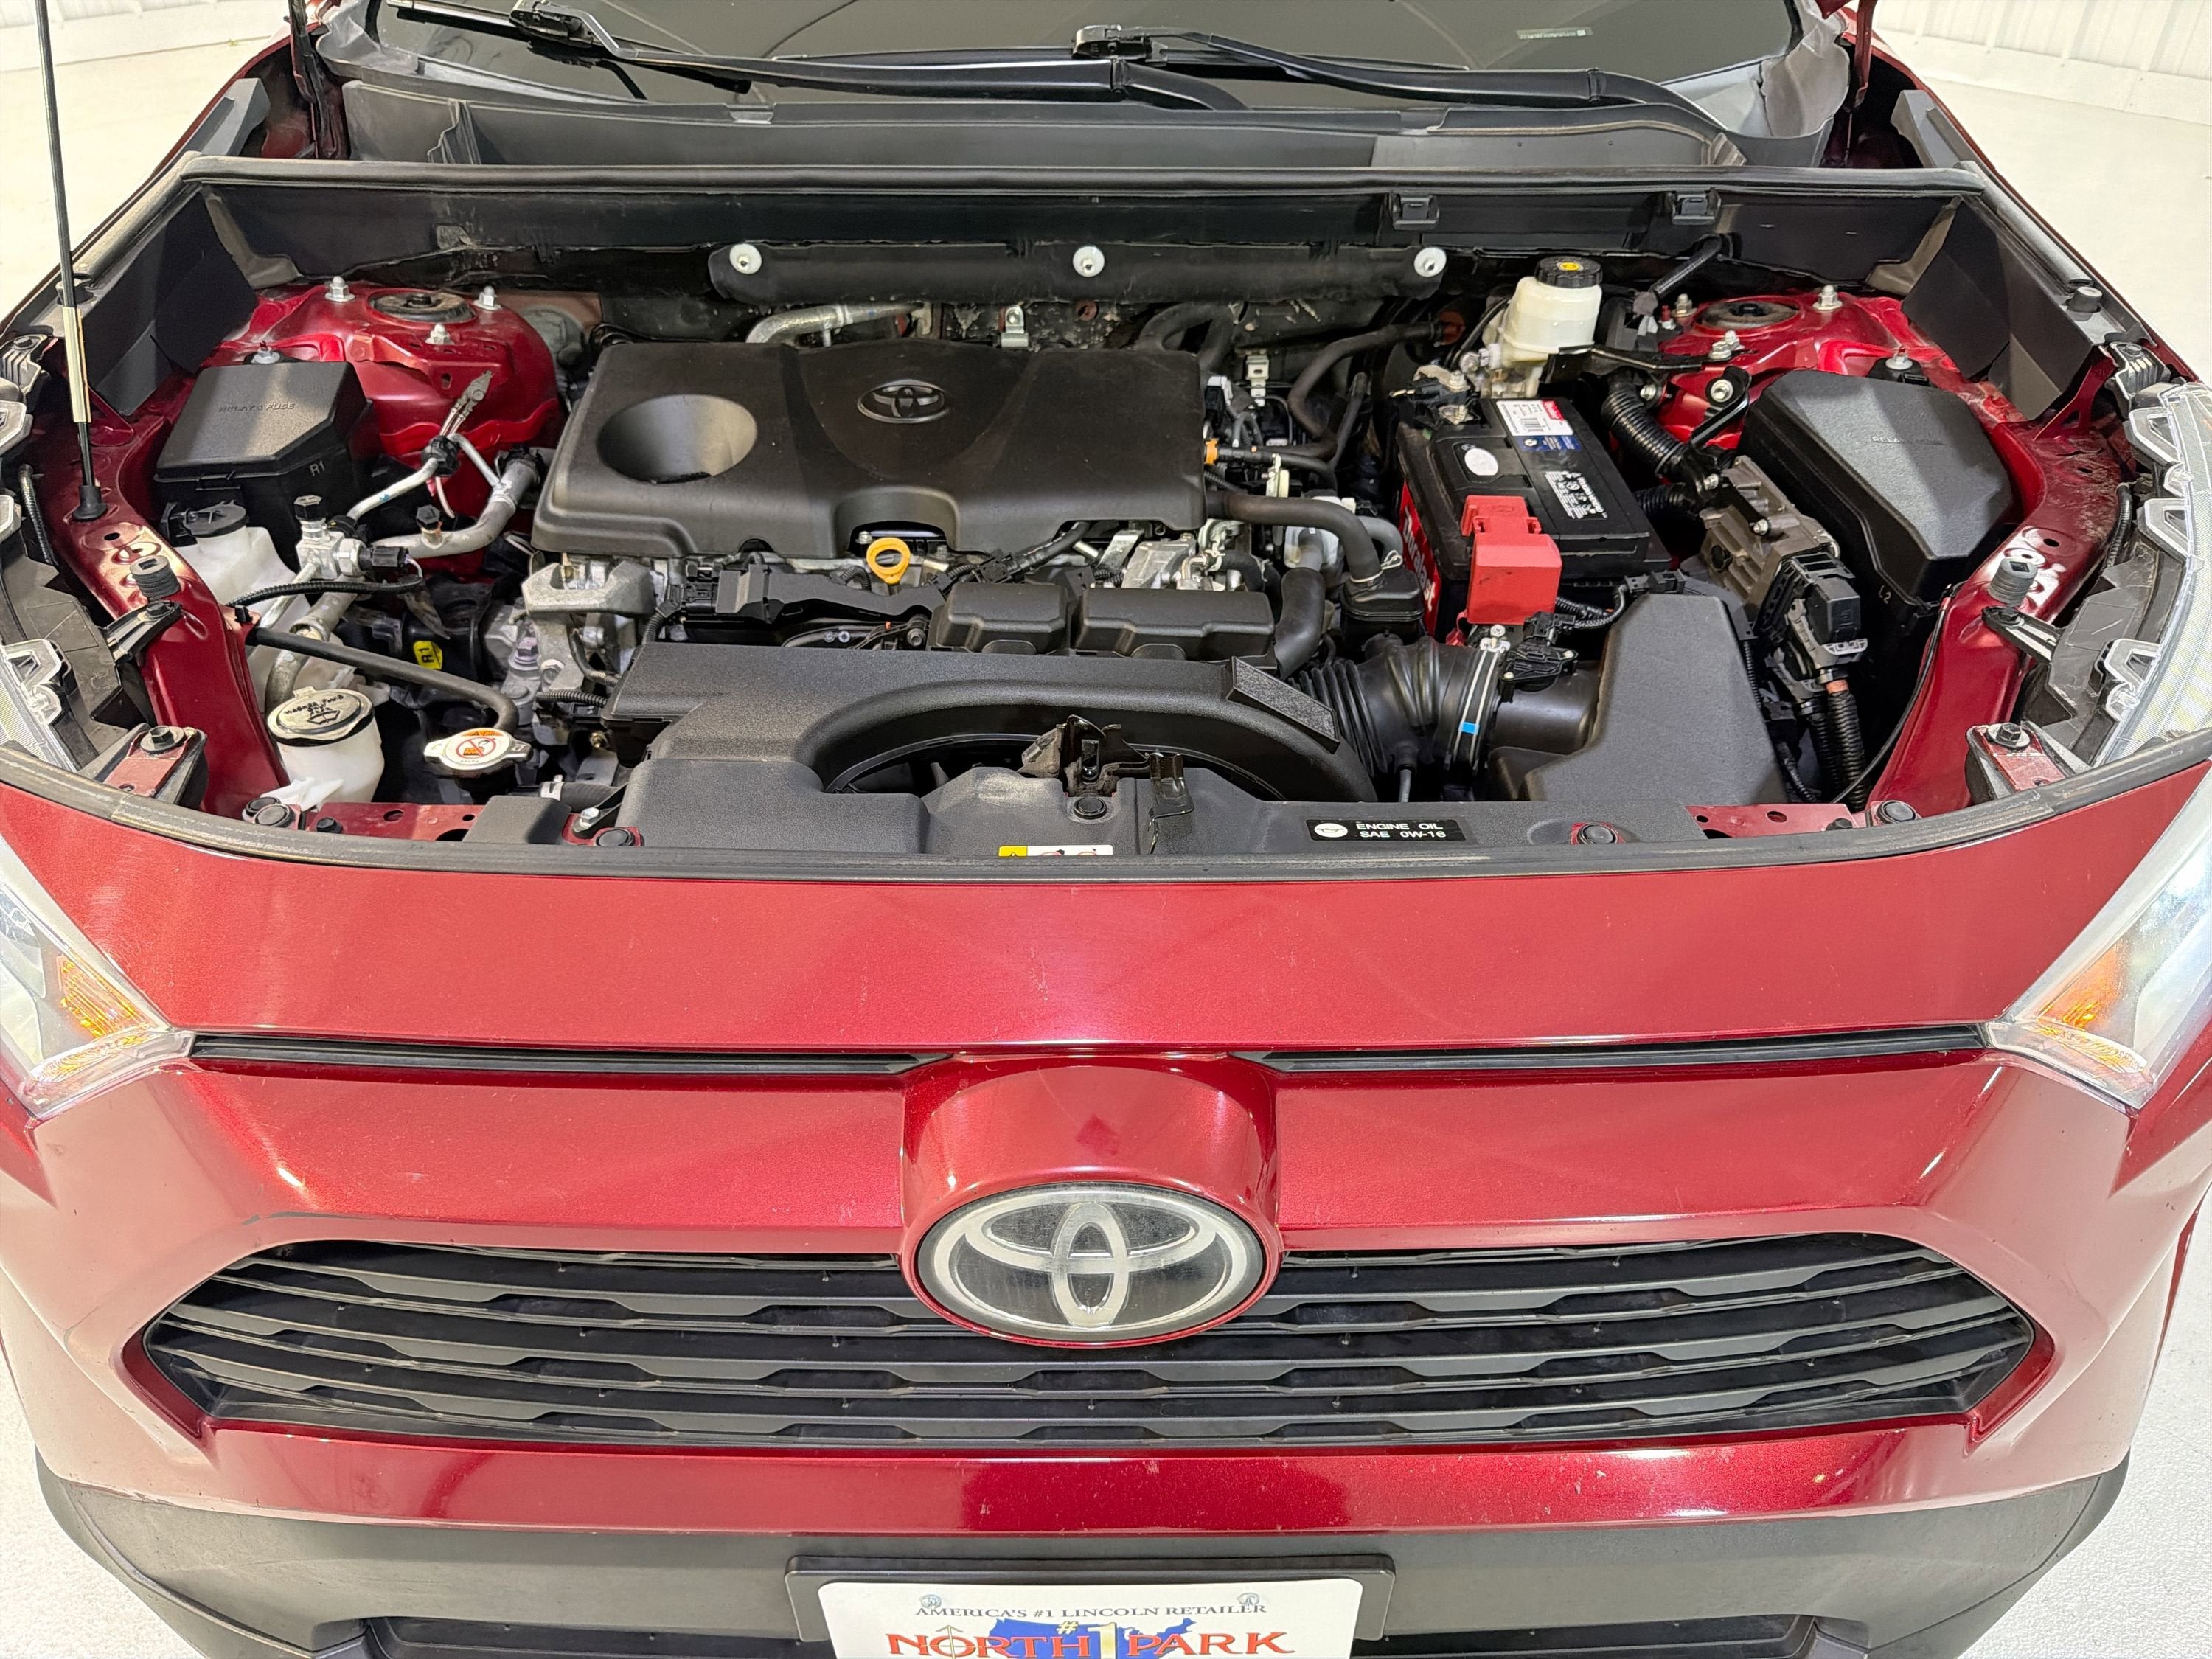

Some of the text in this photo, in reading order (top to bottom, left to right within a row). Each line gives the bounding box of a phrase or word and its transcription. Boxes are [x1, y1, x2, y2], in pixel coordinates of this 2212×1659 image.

[265, 402, 296, 411] FUSE
[309, 460, 325, 478] R1
[417, 647, 435, 664] R1
[1355, 822, 1444, 830] ENGINE OIL
[1359, 830, 1447, 838] SAE 0W-16
[914, 1604, 1267, 1618] AMERICA'S #1 LINCOLN RETAILER
[885, 1631, 1296, 1658] NORTH PARK
